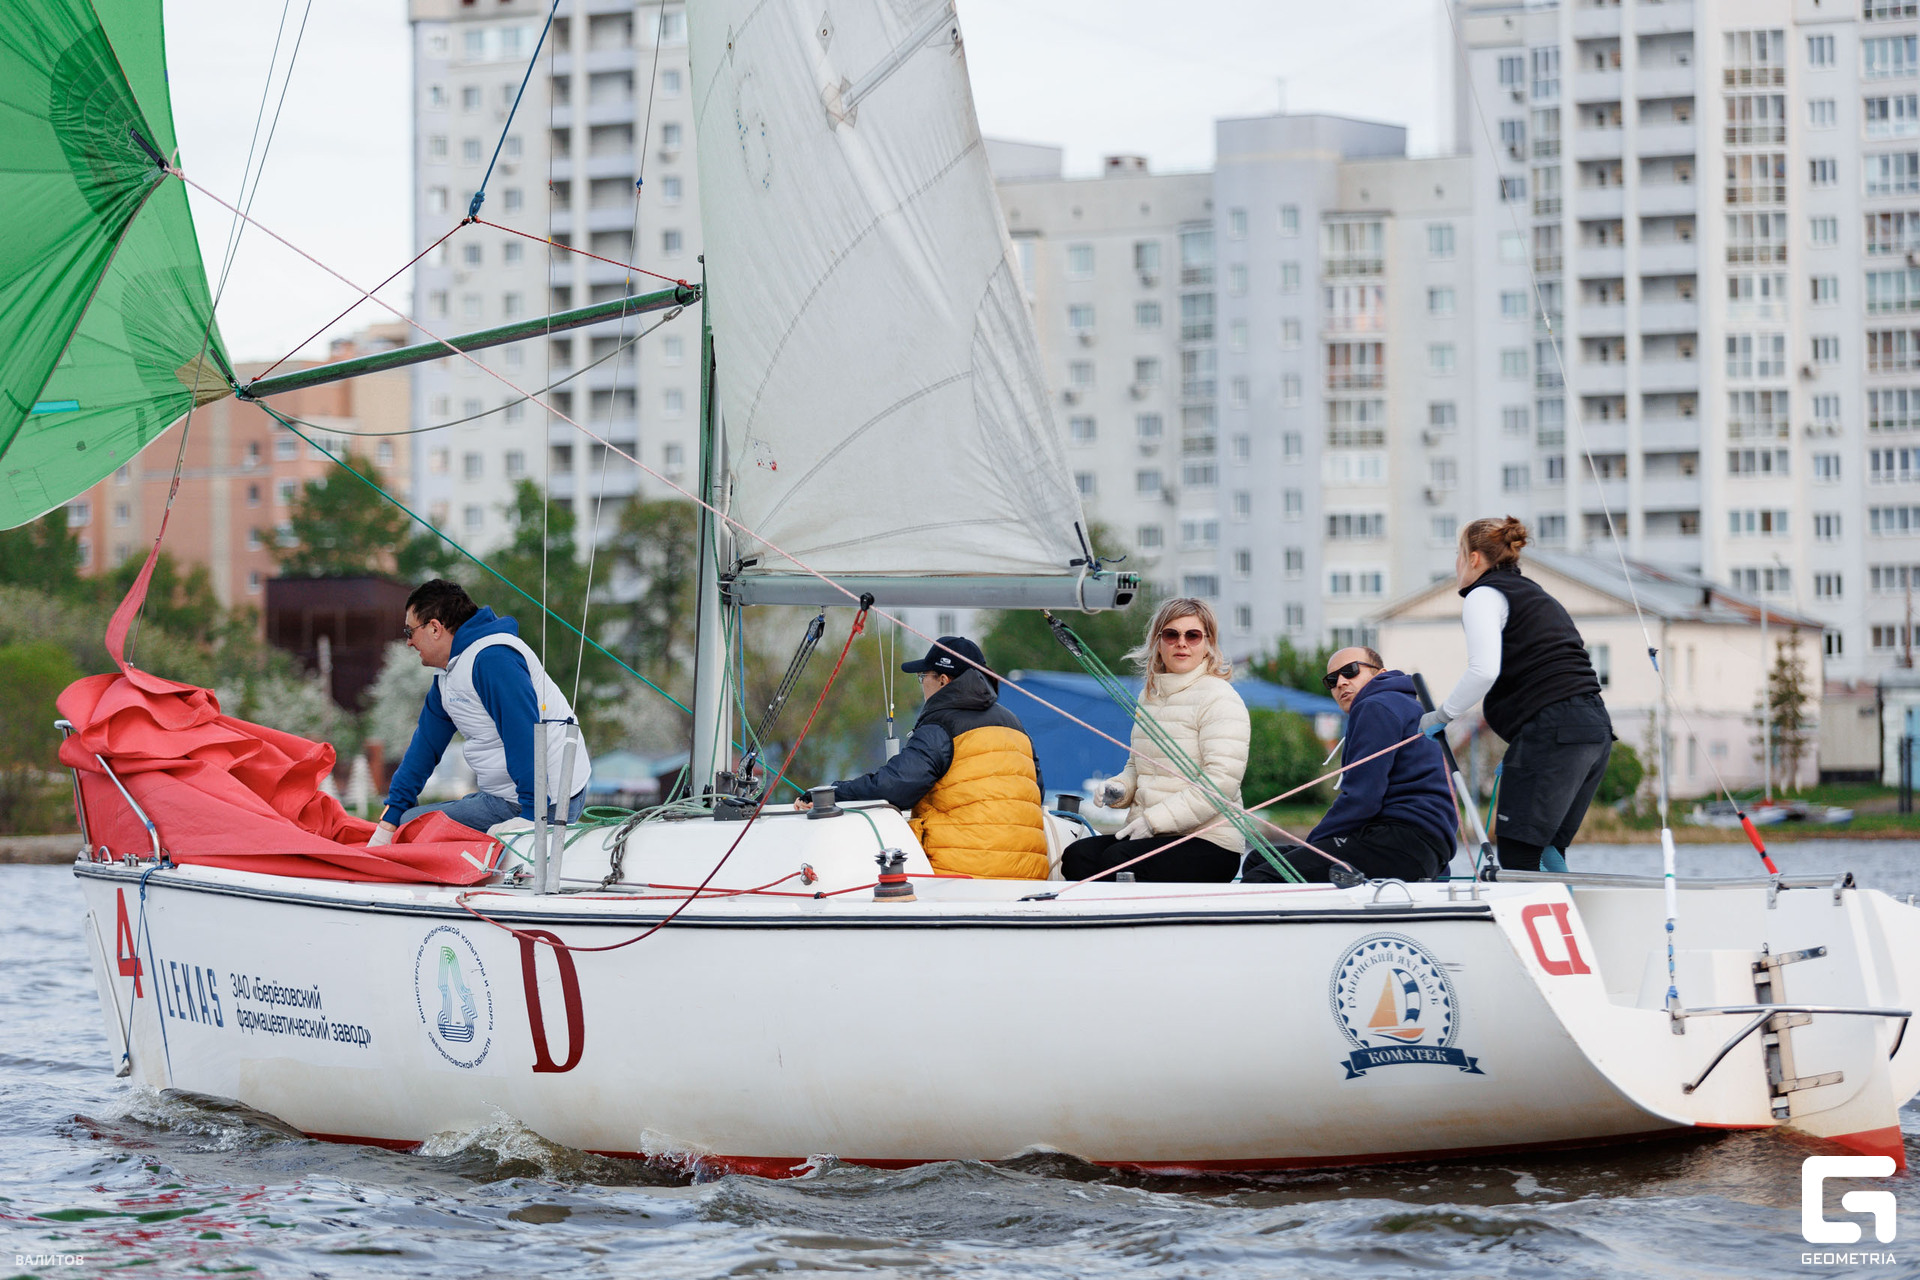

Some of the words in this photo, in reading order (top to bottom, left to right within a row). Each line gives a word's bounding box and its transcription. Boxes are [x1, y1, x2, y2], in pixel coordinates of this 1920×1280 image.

[117, 888, 144, 998] 4
[160, 959, 224, 1028] LEKAS
[230, 973, 250, 1000] ЗАО
[252, 977, 322, 1010] «Берёзовский
[423, 925, 460, 945] ФИЗИЧЕСКОЙ
[461, 934, 486, 977] КУЛЬТУРЫ
[486, 990, 494, 1031] СПОРТА
[512, 929, 585, 1073] D
[1347, 951, 1393, 1009] ГУБЕРНСКИЙ
[1397, 955, 1440, 1005] ЯХТ-КЛУБ
[236, 1002, 331, 1041] фармацевтический
[331, 1022, 372, 1049] завод»
[428, 1031, 474, 1069] СВЕРДЛОВСКОЙ
[474, 1036, 492, 1067] ОБЛАСТИ
[1367, 1049, 1448, 1065] КОМАТЕК
